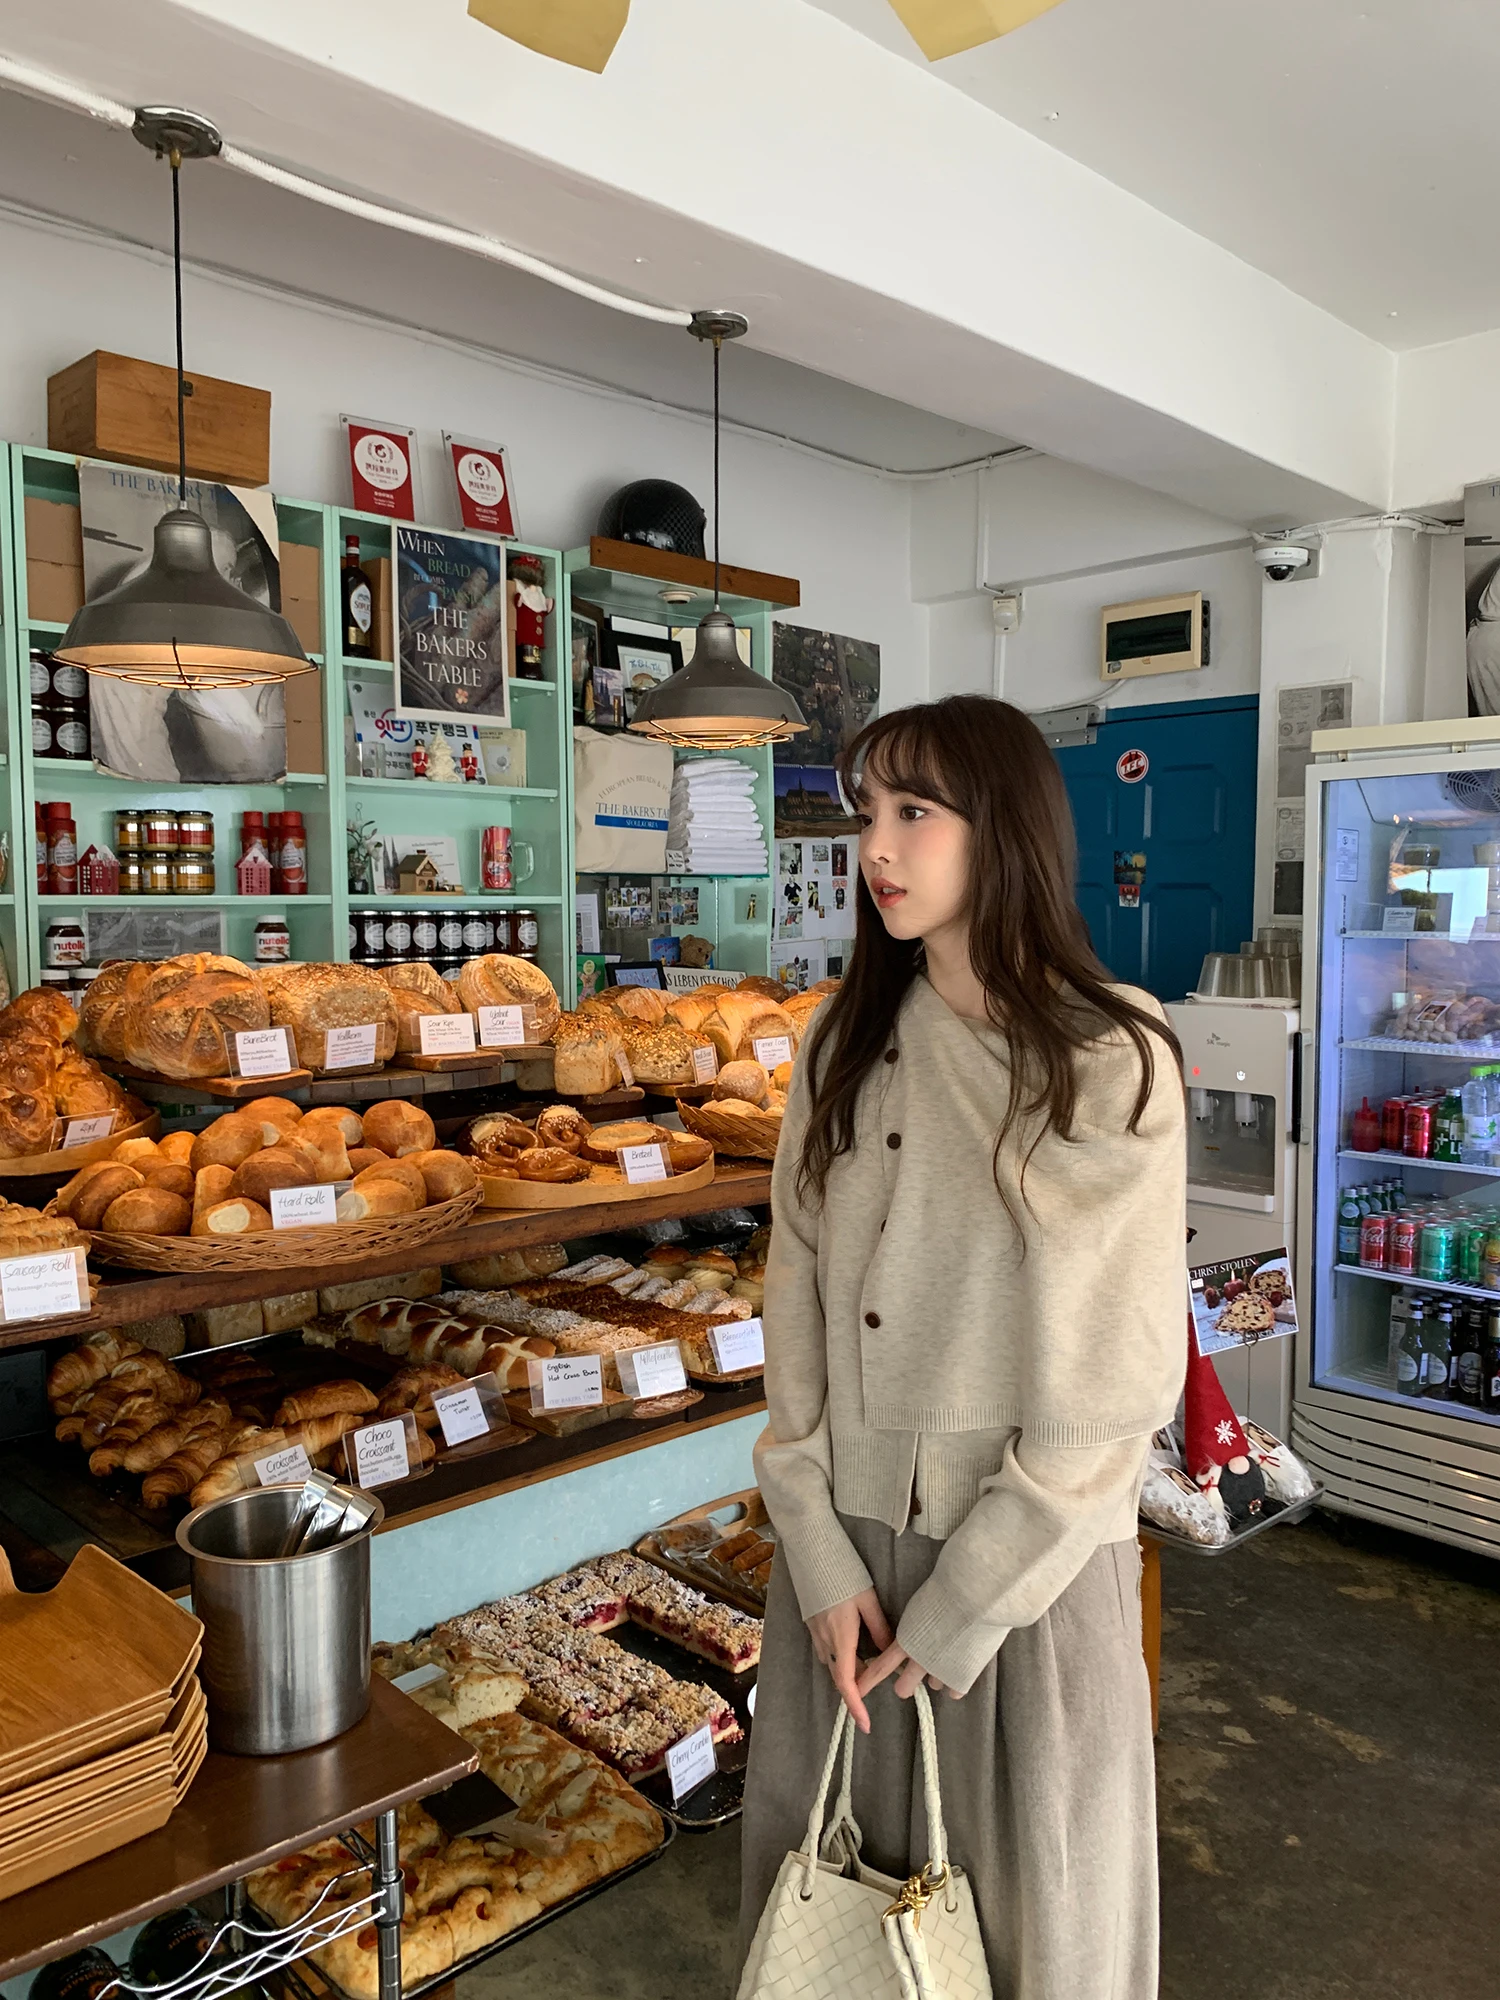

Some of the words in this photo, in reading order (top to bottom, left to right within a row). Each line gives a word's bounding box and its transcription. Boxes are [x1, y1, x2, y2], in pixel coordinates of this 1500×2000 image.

[108, 471, 140, 489] THE
[398, 530, 445, 556] WHEN
[428, 558, 471, 578] BREAD
[428, 605, 468, 629] THE
[416, 632, 487, 660] BAKERS
[423, 661, 482, 687] TABLE
[416, 721, 468, 737] 푸드뱅크
[595, 802, 620, 814] THE
[674, 974, 699, 987] LEBEN
[427, 1019, 441, 1028] Sour
[491, 1017, 505, 1027] Sour
[632, 1147, 653, 1160] Bretzel
[278, 1194, 301, 1208] Hard
[305, 1190, 326, 1205] Rolls
[3, 1263, 47, 1280] Sausage
[51, 1254, 72, 1271] Roll
[1189, 1266, 1218, 1280] CHRIST
[1220, 1257, 1257, 1273] STOLLEN
[547, 1362, 571, 1373] English
[582, 1368, 599, 1377] Buns
[364, 1428, 392, 1445] Choco
[358, 1440, 396, 1460] Croissant
[266, 1449, 300, 1473] Croissant
[672, 1749, 690, 1768] Cherry
